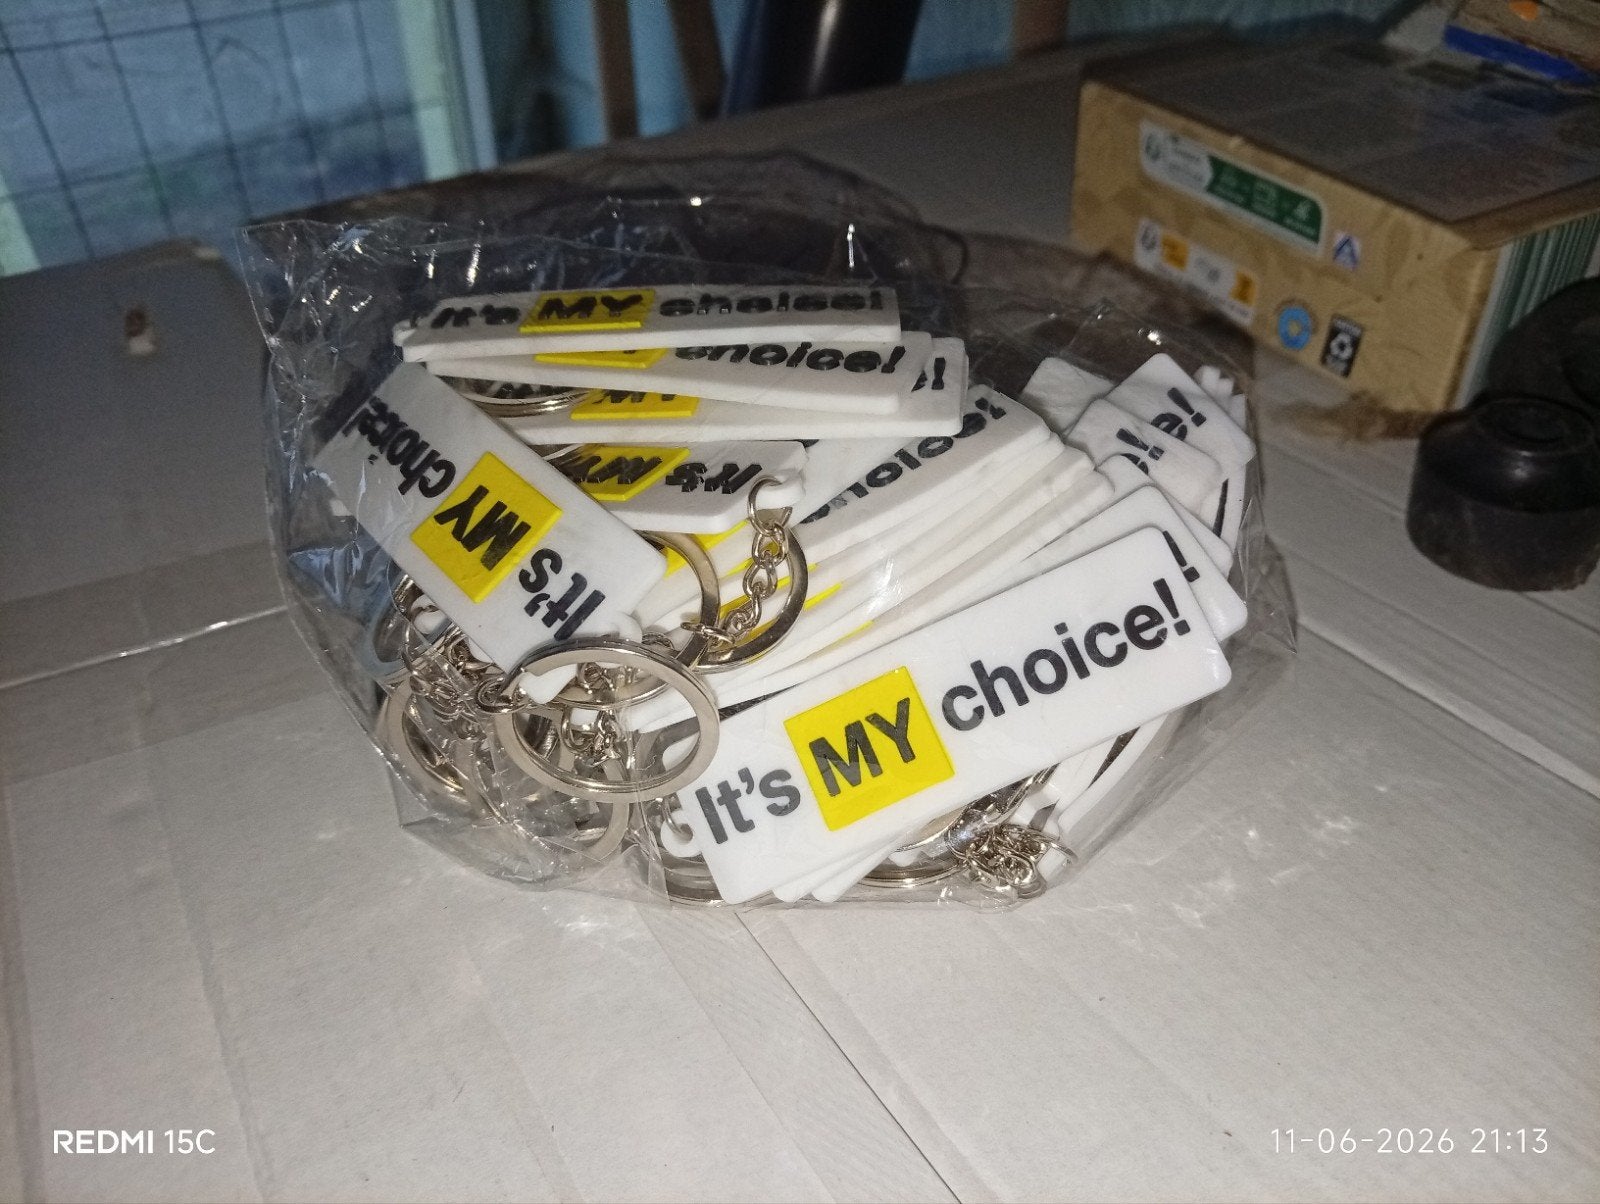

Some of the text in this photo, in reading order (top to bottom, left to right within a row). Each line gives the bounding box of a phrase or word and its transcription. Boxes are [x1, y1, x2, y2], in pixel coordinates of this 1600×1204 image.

[537, 293, 643, 320] MY
[659, 290, 884, 317] choice!
[433, 484, 532, 572] MY
[518, 547, 606, 641] It's
[696, 577, 1192, 844] It's MY choice!
